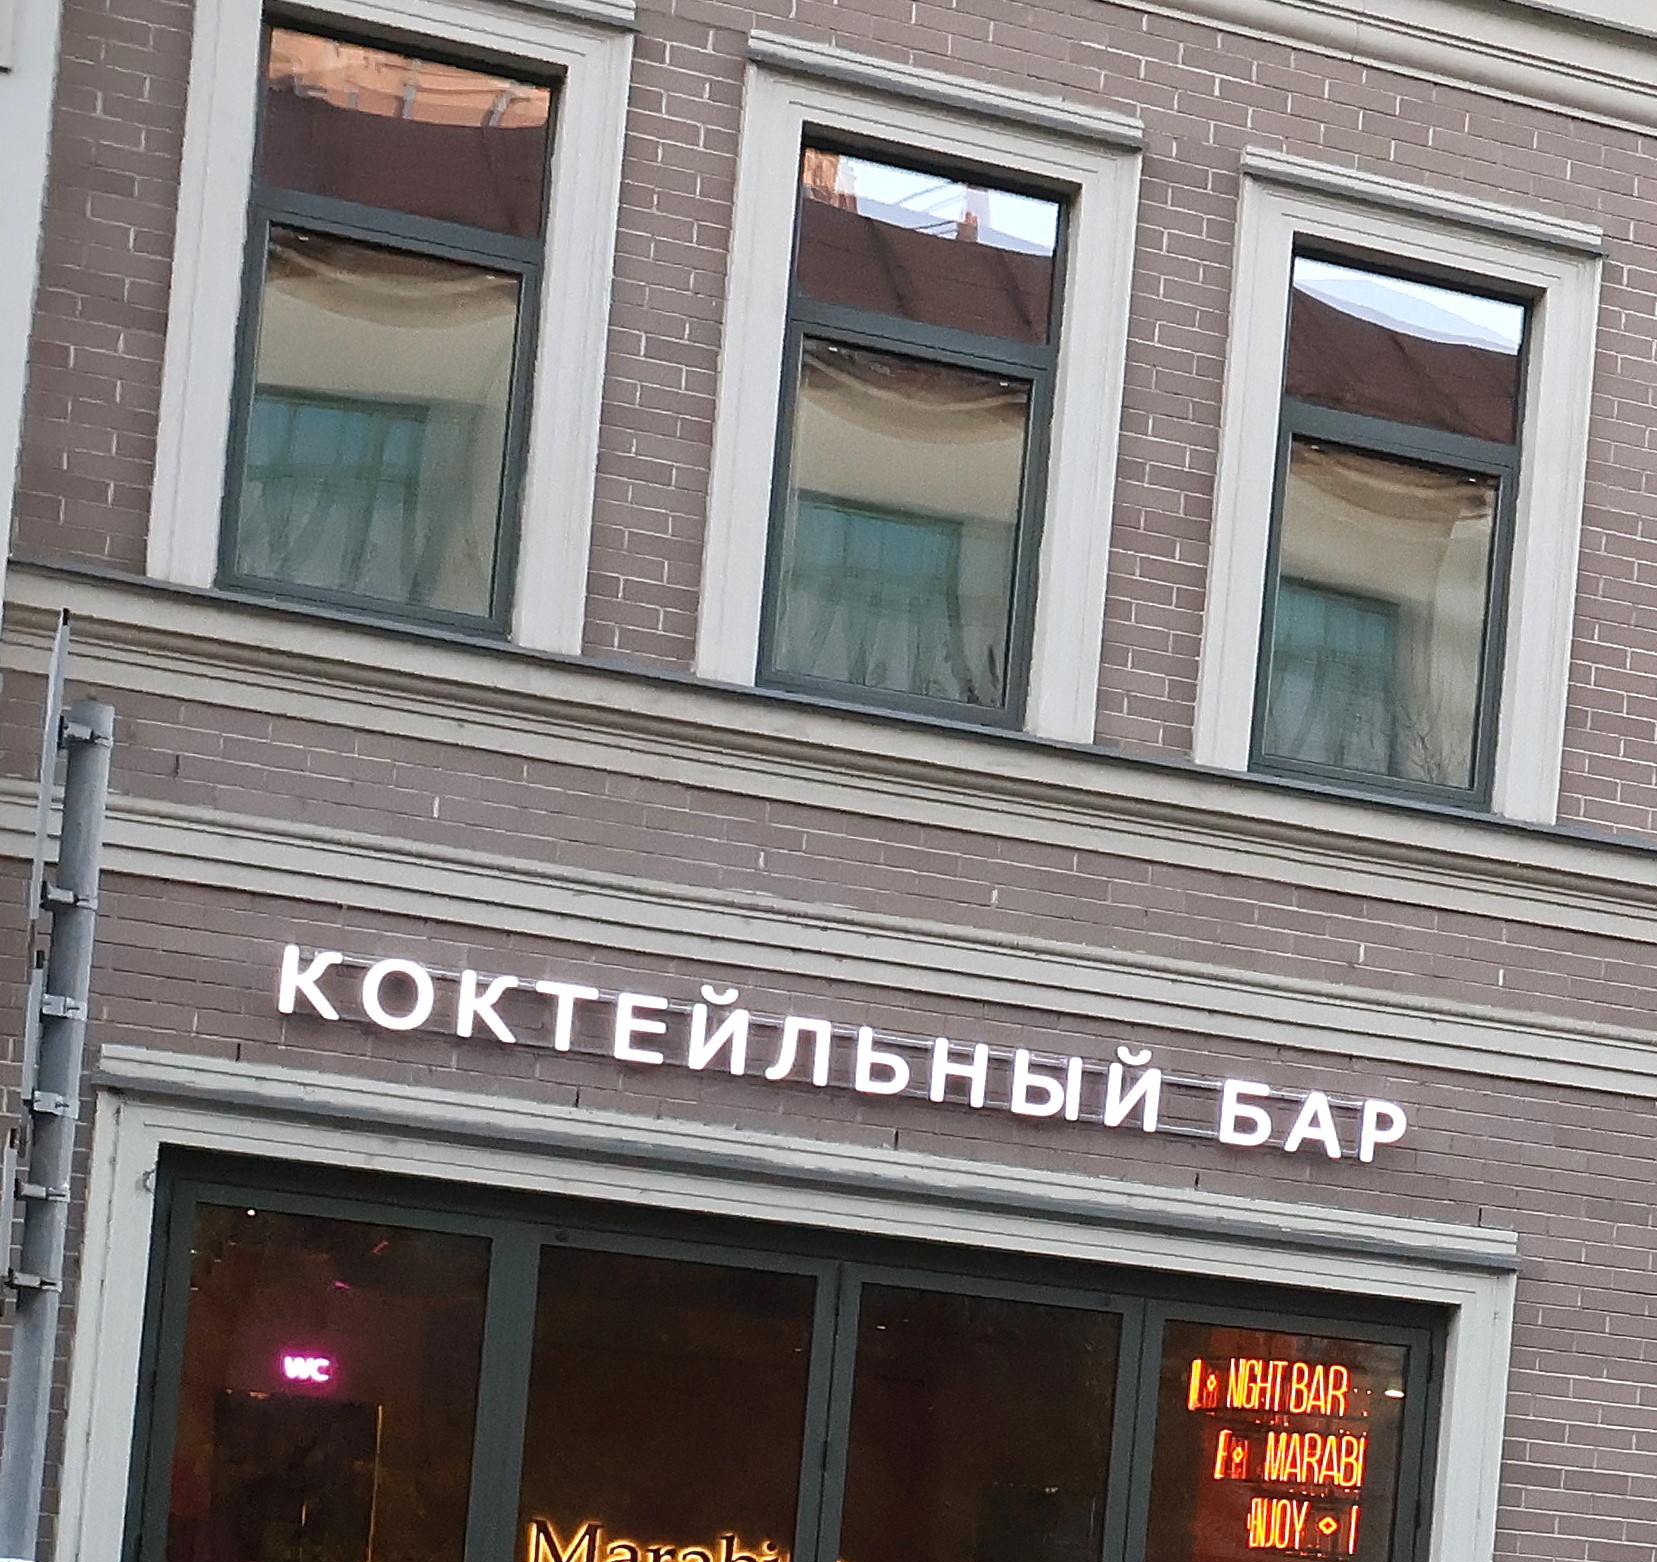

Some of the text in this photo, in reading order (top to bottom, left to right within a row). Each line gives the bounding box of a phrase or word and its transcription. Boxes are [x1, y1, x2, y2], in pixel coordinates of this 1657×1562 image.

[277, 944, 1407, 1163] КОКТЕЙЛЬНЫЙ БАР
[284, 1356, 330, 1382] WC
[1289, 1362, 1349, 1417] BAR
